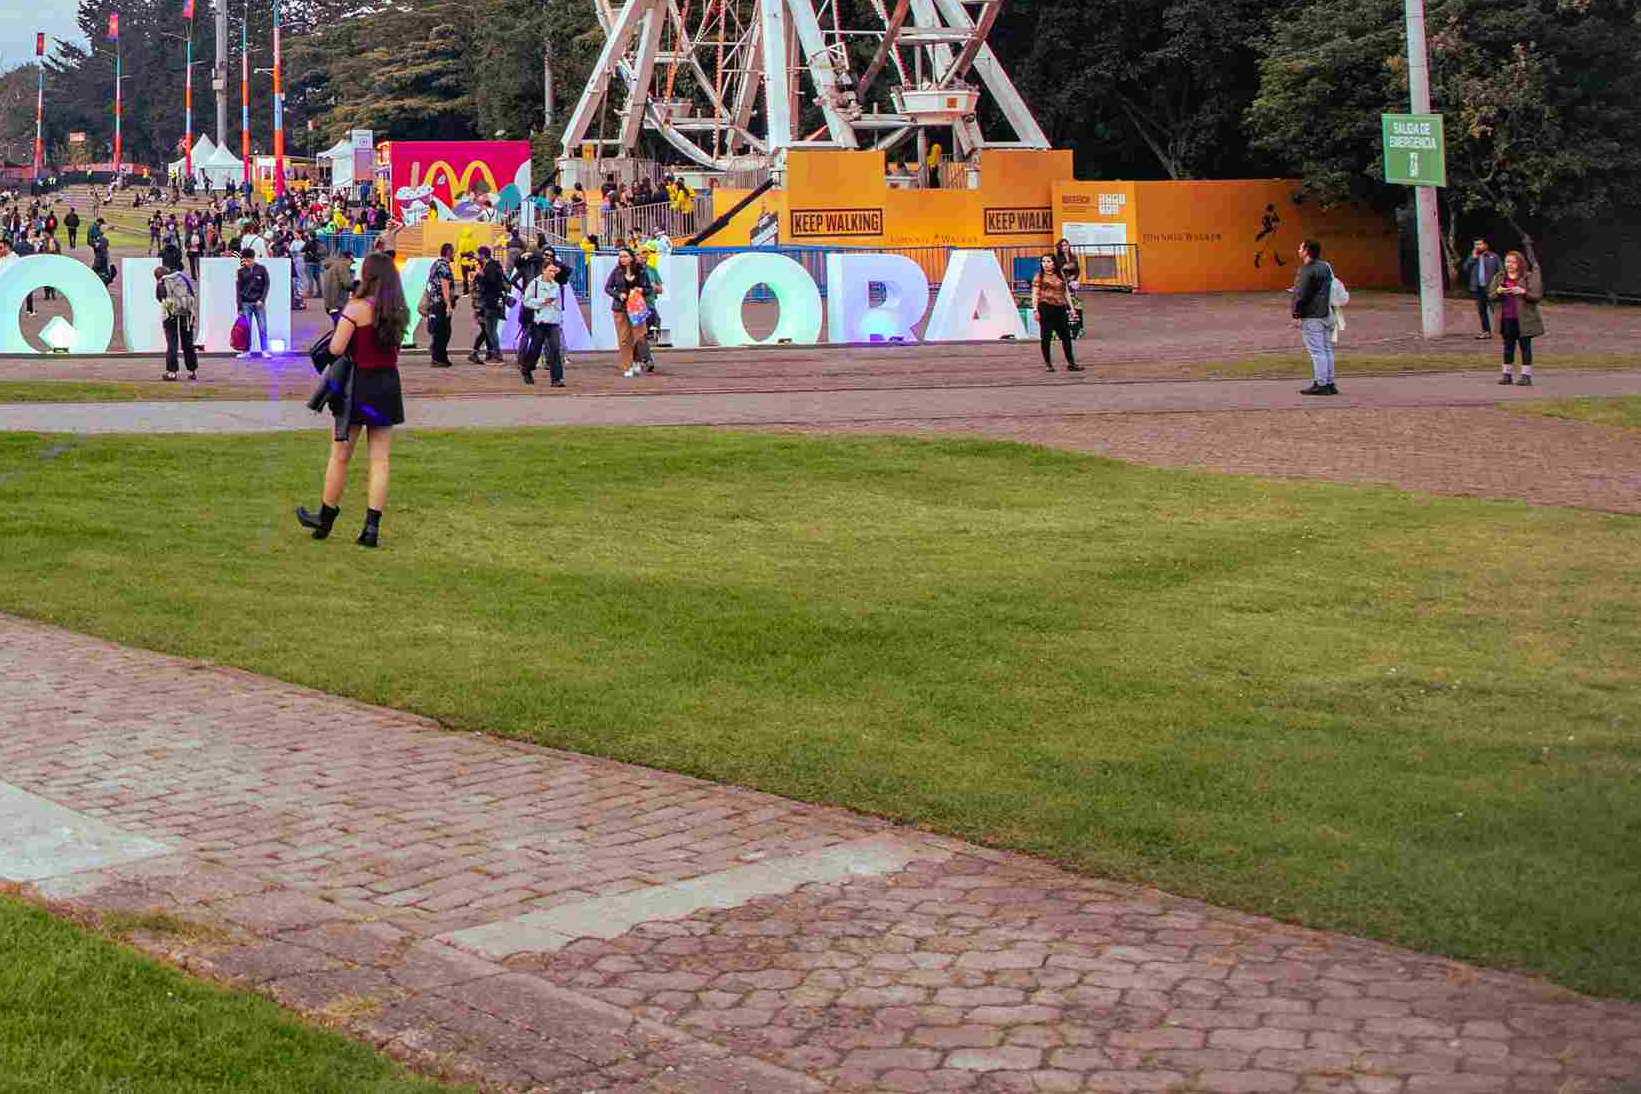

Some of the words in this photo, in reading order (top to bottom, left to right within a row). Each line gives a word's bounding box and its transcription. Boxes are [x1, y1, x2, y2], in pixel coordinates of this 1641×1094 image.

[794, 211, 823, 233] KEEP
[825, 210, 880, 232] WALKING
[987, 210, 1015, 231] KEEP
